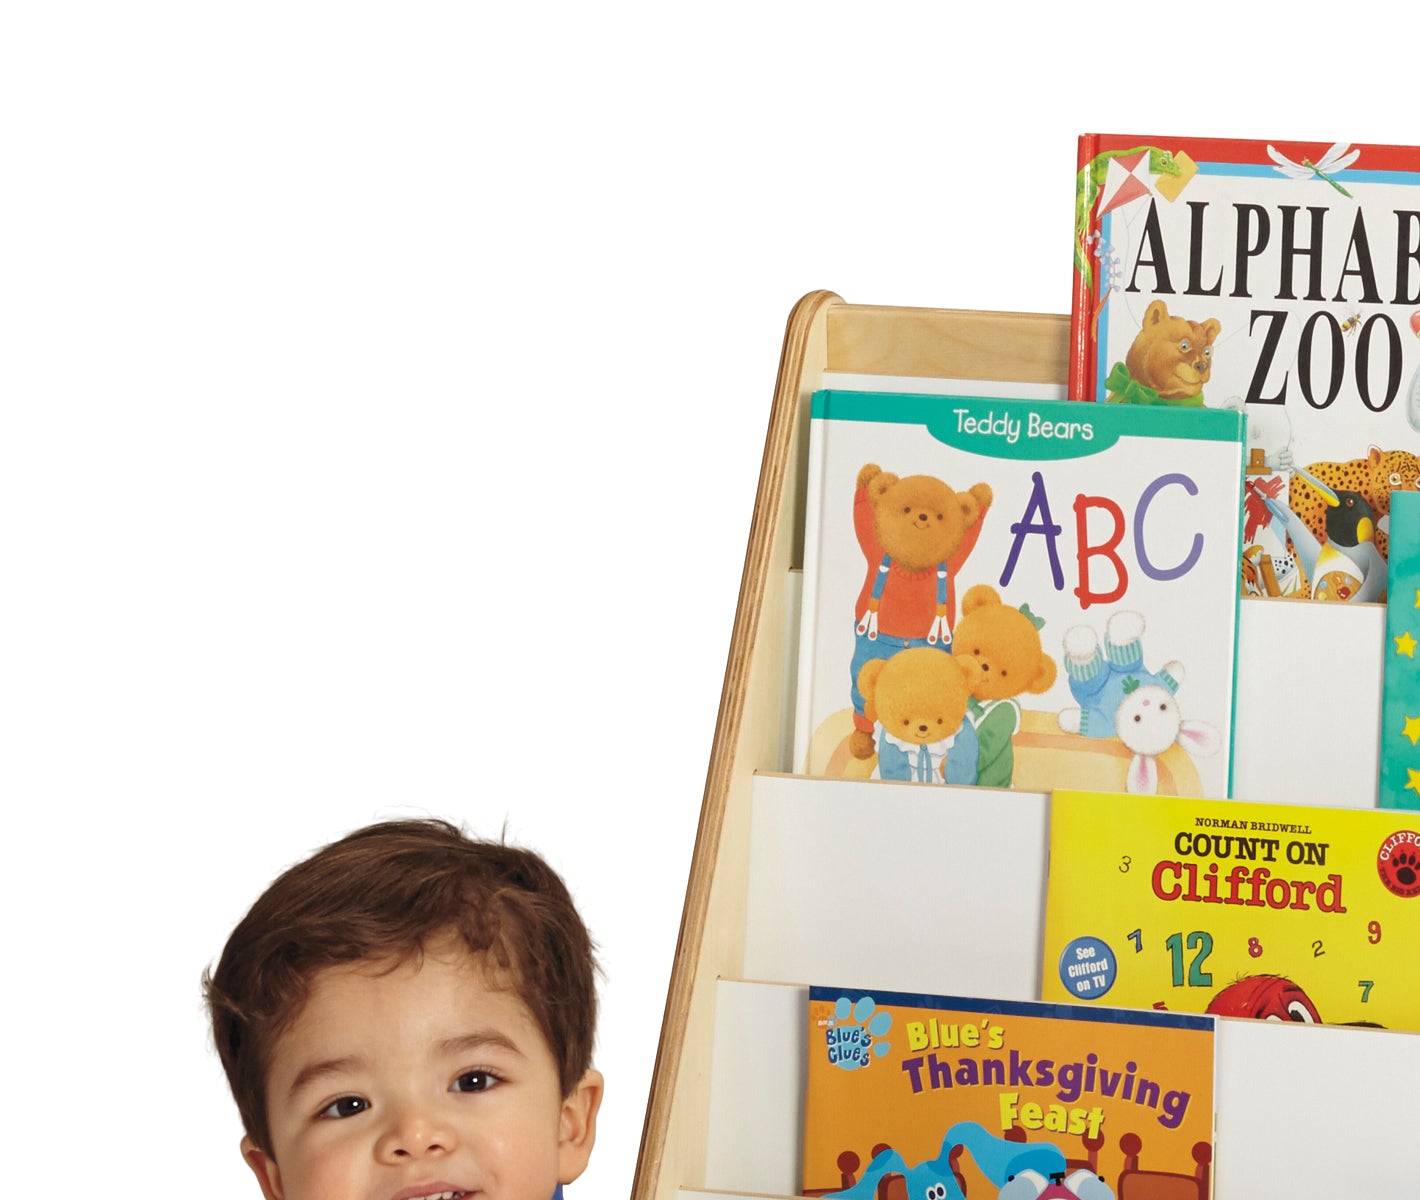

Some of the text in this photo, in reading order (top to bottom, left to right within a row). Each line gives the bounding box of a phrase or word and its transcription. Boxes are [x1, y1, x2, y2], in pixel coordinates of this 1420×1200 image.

[1245, 309, 1403, 413] ZOO
[953, 409, 1094, 443] Teddy Bears
[999, 471, 1204, 609] ABC
[1195, 817, 1312, 835] NORMAN BRIDWELL
[1174, 832, 1330, 866] COUNT ON
[1118, 855, 1132, 874] 3
[1151, 860, 1347, 914] Clifford
[1127, 928, 1143, 953] 7
[1367, 920, 1383, 945] 9
[1076, 946, 1095, 960] See
[1165, 930, 1214, 988] 12
[1247, 937, 1264, 958] 8
[1311, 940, 1326, 958] 2
[1068, 958, 1109, 978] Clifford
[1076, 974, 1106, 992] on TV
[1357, 980, 1375, 1003] 7
[826, 1026, 872, 1049] Blue's
[906, 1017, 1005, 1051] Blue's
[828, 1045, 871, 1068] Clues
[902, 1049, 1191, 1129] Thanksgiving
[999, 1092, 1105, 1139] Feast
